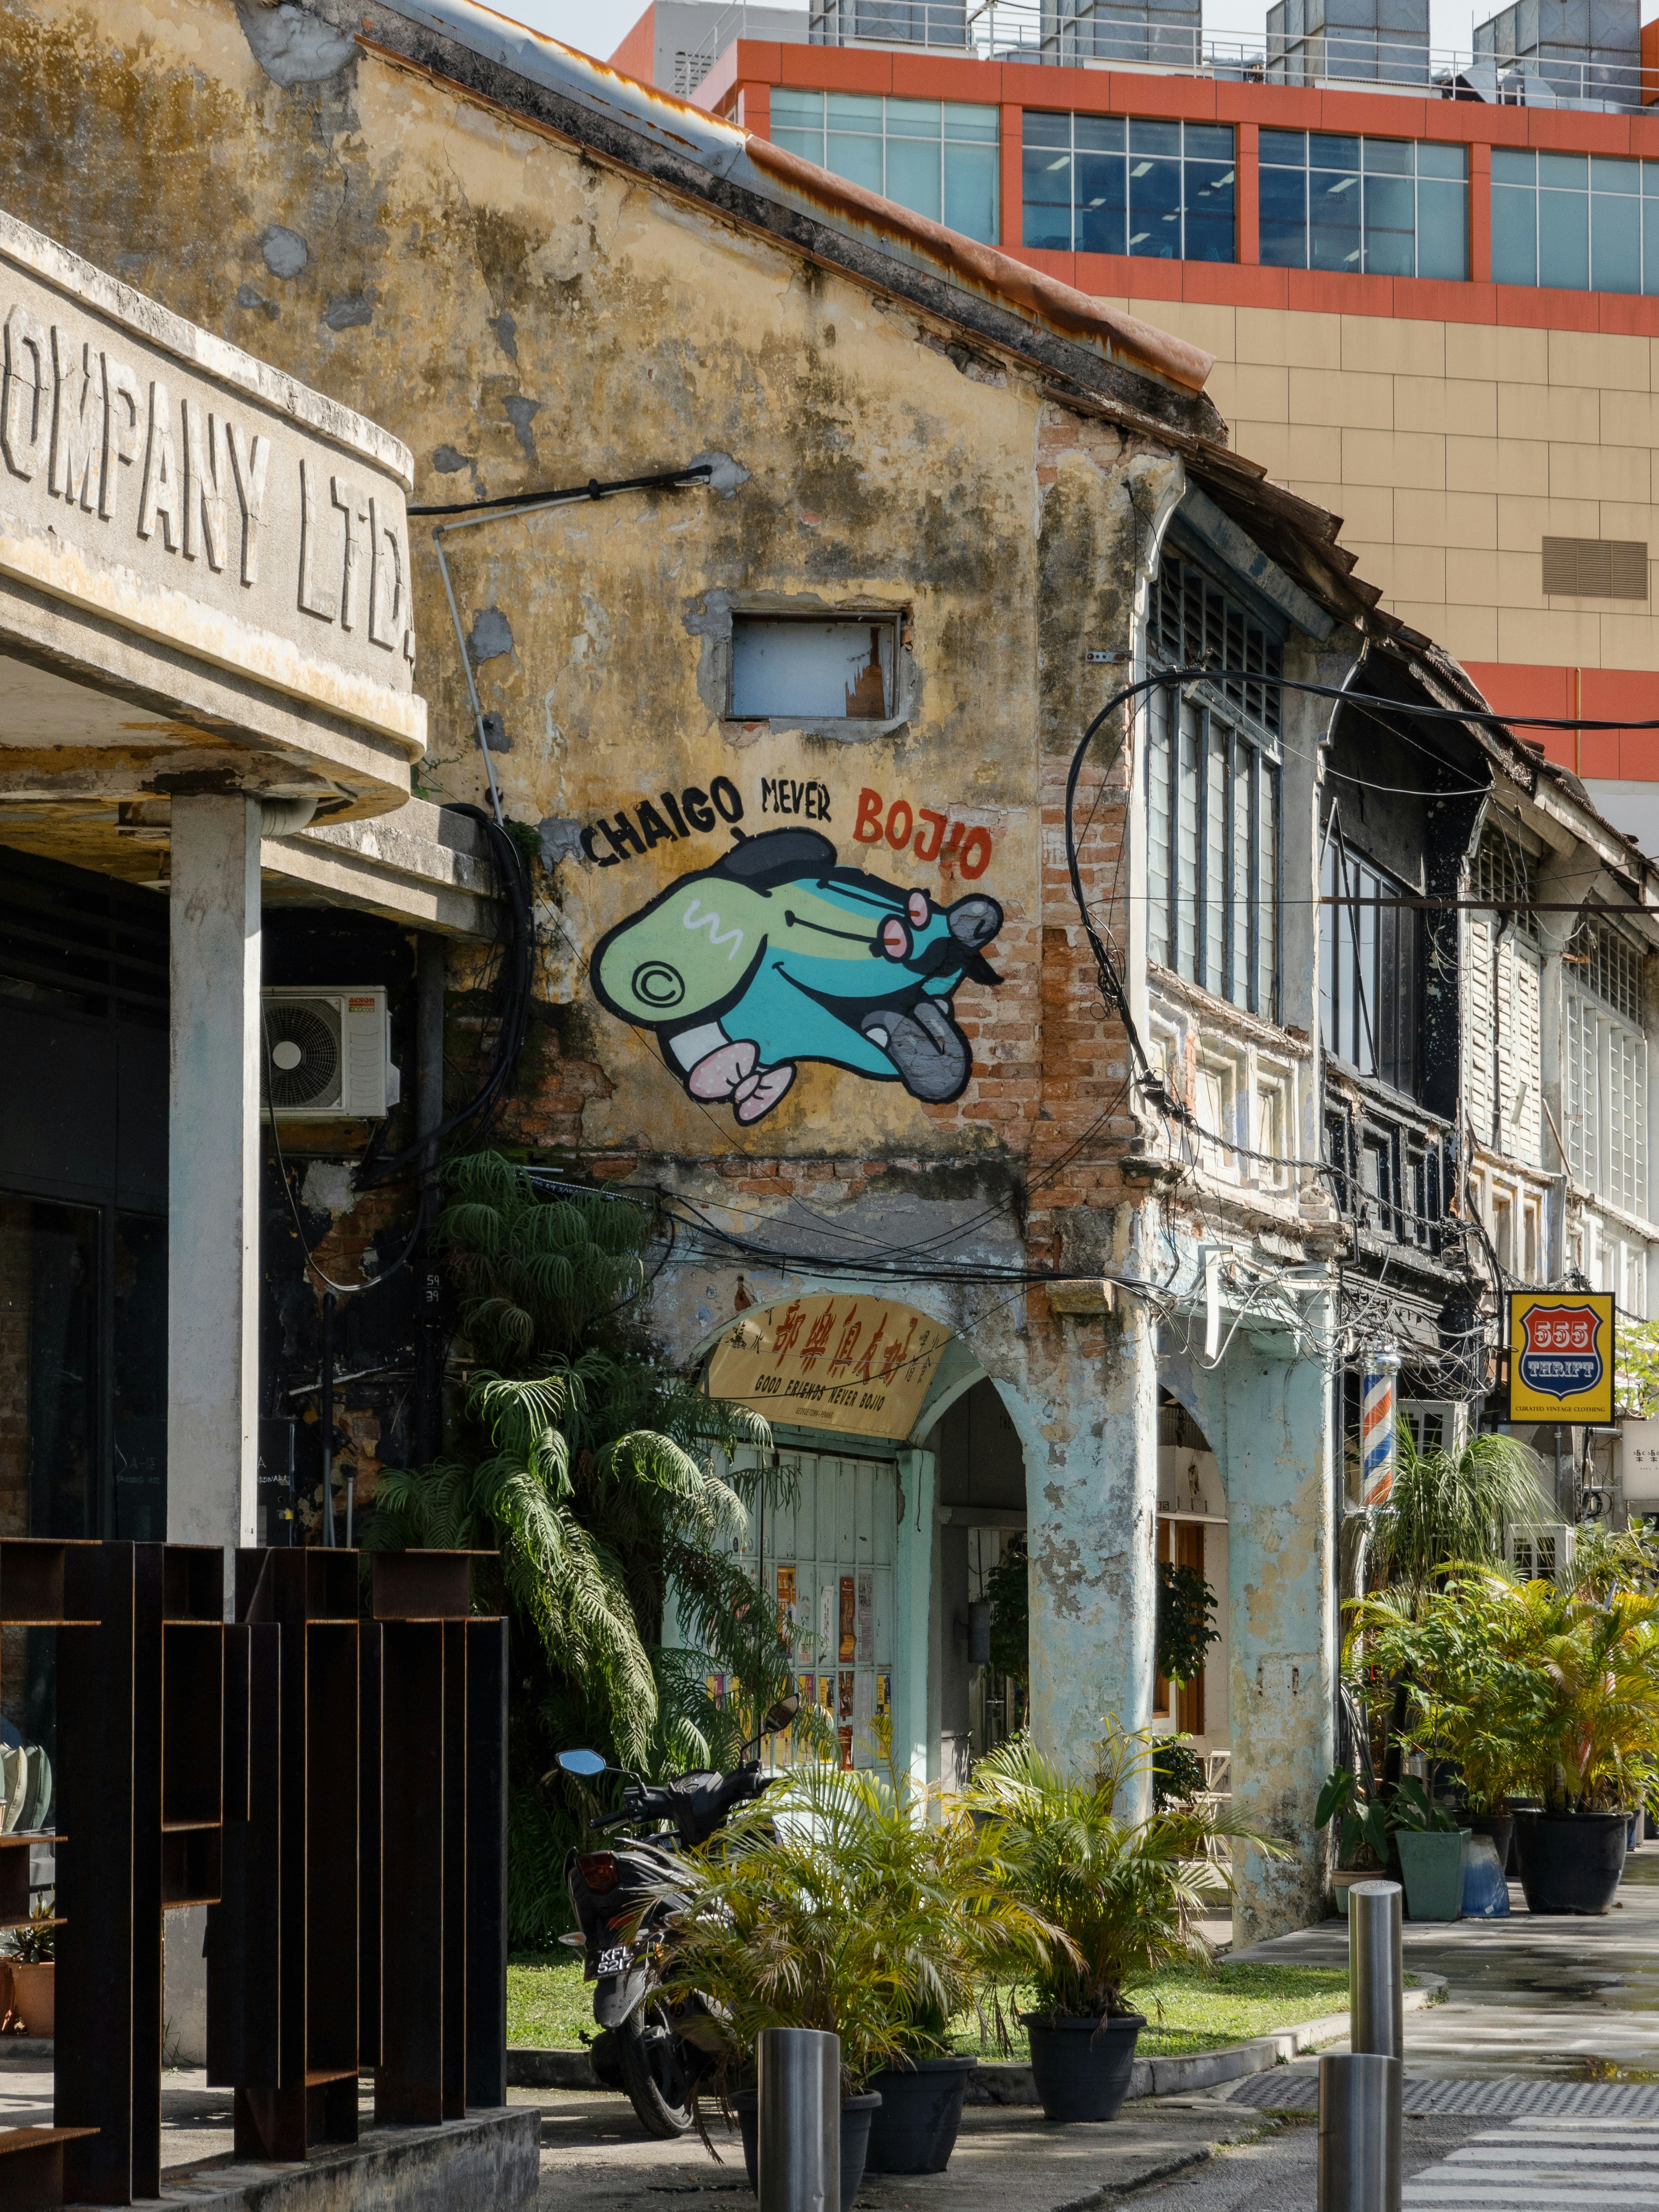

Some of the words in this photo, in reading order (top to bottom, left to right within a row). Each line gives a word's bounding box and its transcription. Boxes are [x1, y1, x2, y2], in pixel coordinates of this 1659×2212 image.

[580, 775, 744, 868] CHAIGO
[853, 788, 992, 880] BOJIO
[1533, 1321, 1589, 1348] 555
[1528, 1361, 1594, 1377] THRIFT
[754, 1374, 782, 1394] GOOD
[784, 1379, 826, 1401] FRIENDS
[828, 1387, 859, 1407] NEVER
[859, 1392, 885, 1412] BOJIO
